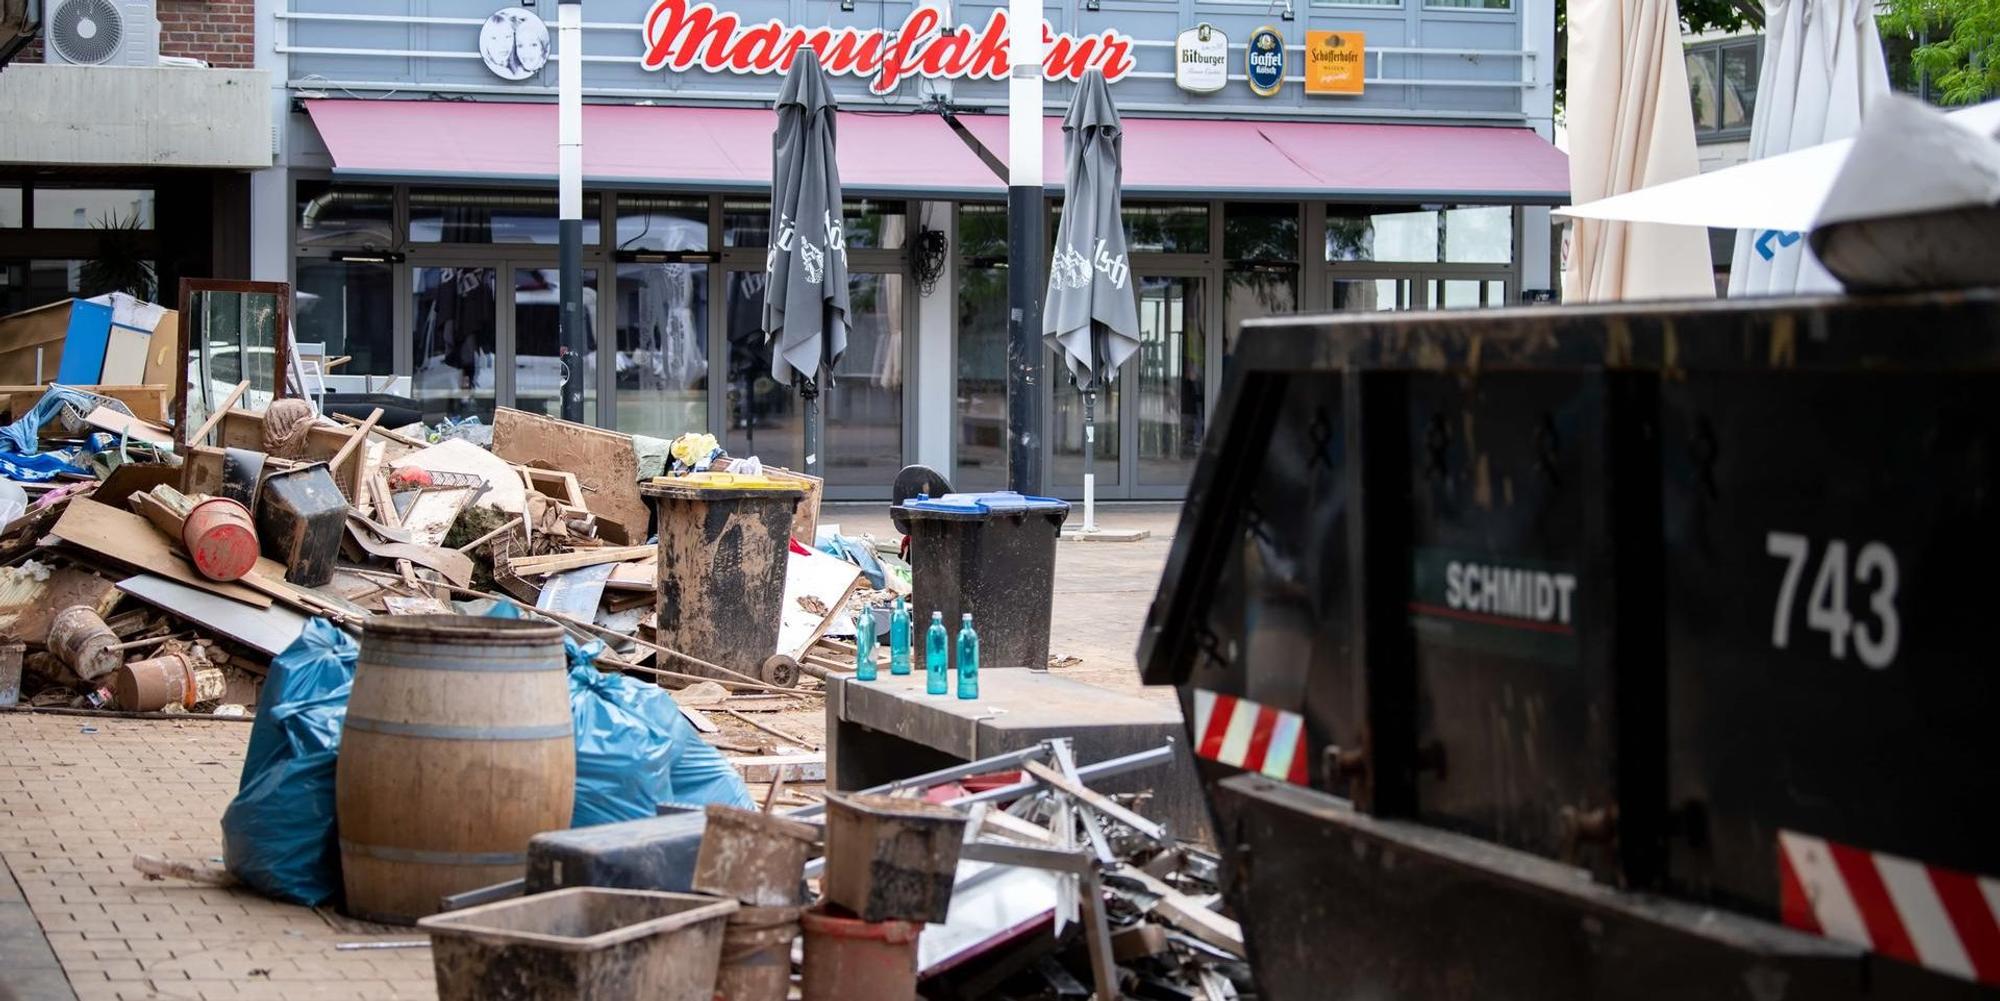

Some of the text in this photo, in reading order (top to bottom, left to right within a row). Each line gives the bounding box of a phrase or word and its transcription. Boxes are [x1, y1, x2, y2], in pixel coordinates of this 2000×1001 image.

[642, 0, 1134, 94] Manufakur
[1182, 49, 1225, 67] Bitburger
[1251, 51, 1283, 68] Gaffel
[1446, 561, 1577, 624] SCHMIDT
[1766, 530, 1901, 671] 743
